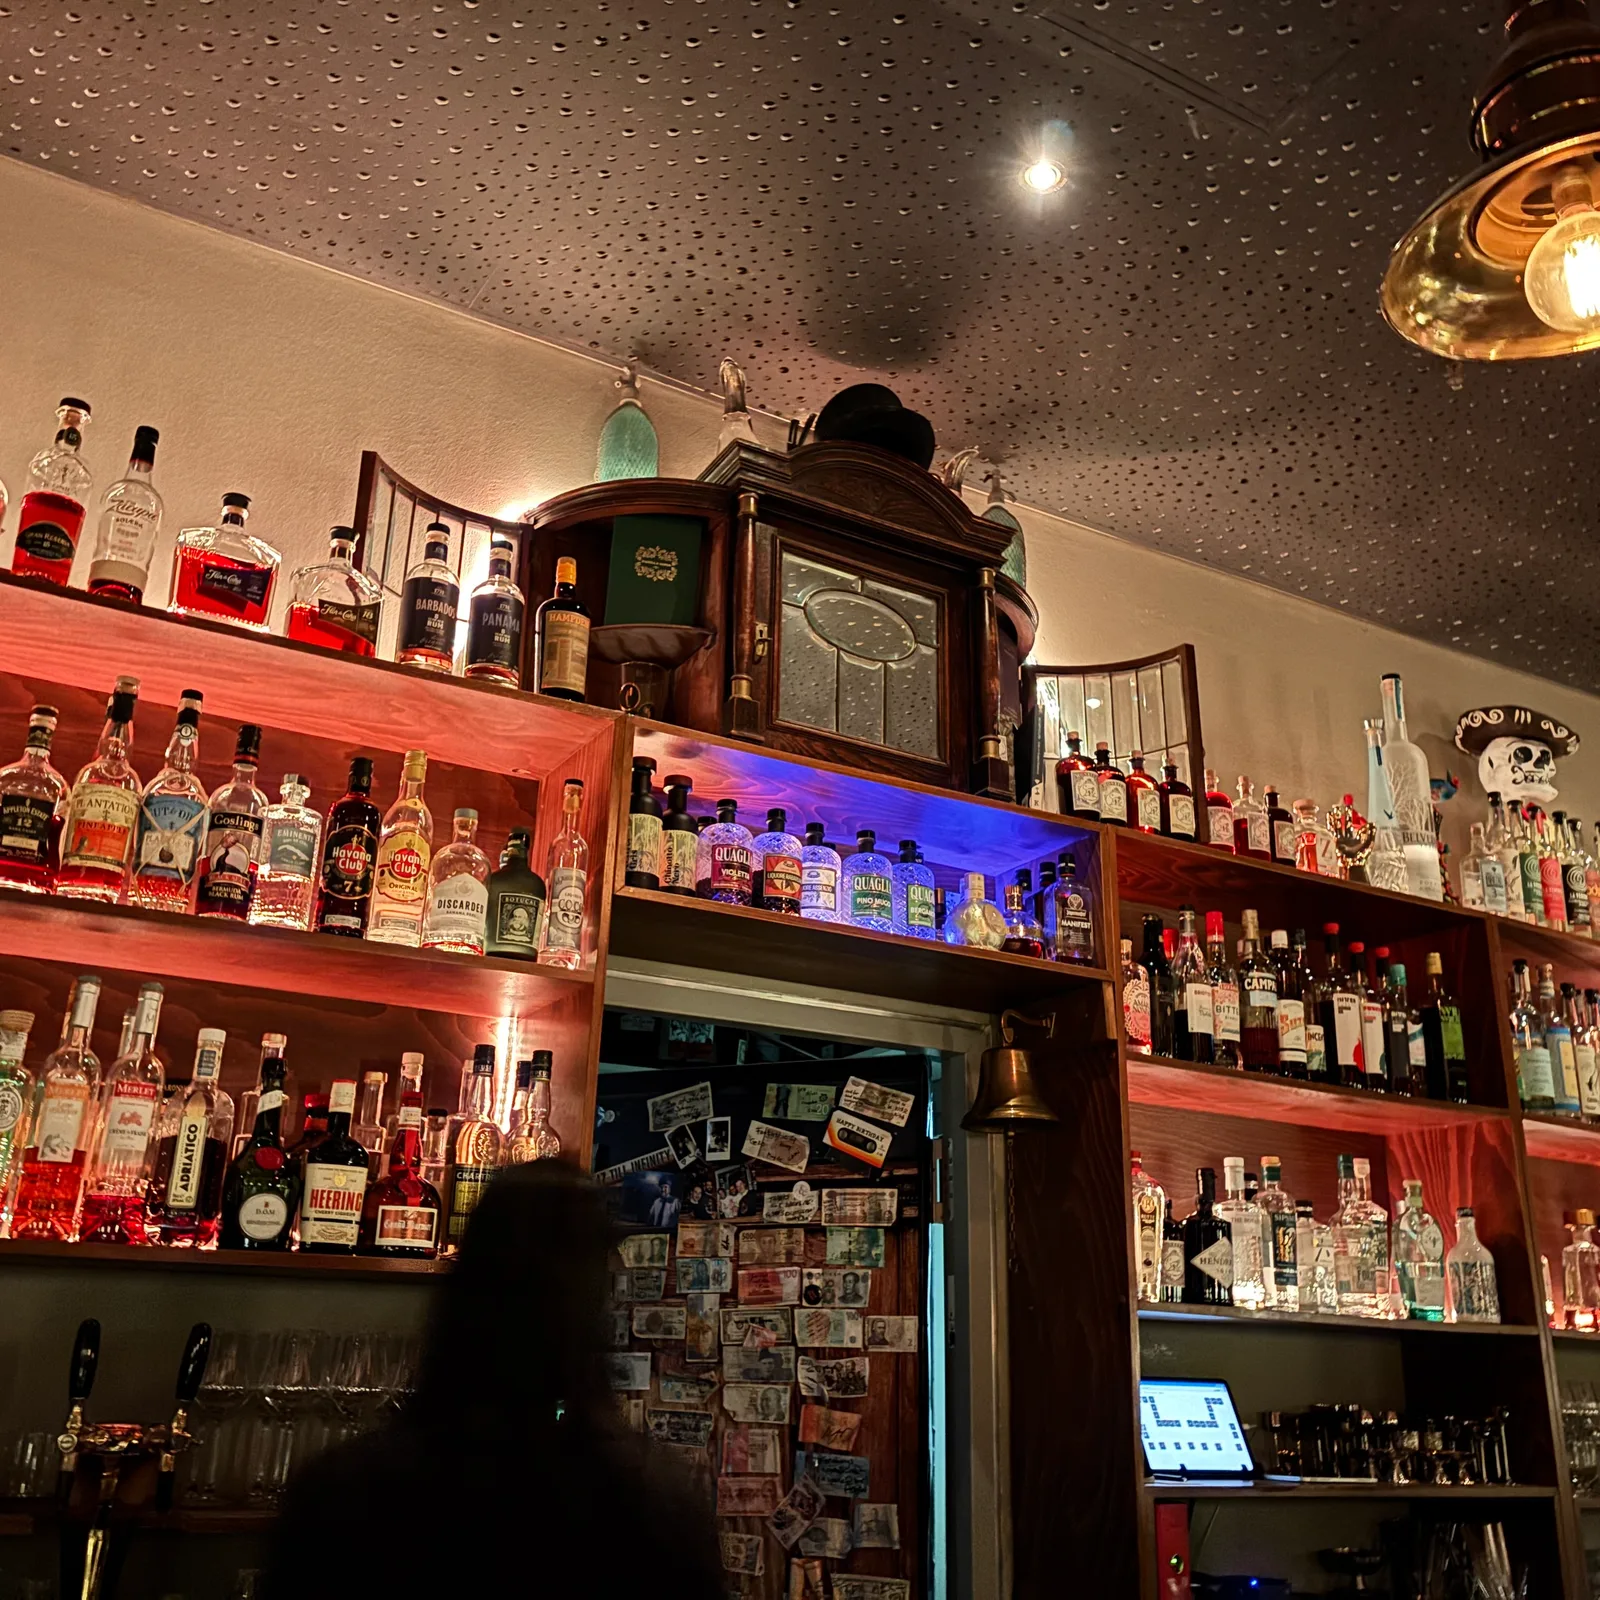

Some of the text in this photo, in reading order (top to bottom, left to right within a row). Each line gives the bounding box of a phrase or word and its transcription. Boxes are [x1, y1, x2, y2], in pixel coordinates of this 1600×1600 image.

[415, 598, 456, 620] BARBADOS
[426, 620, 444, 630] RUM
[482, 612, 520, 634] PANAMA
[493, 635, 511, 645] RUM
[3, 805, 50, 821] APPLETON ESTATE
[76, 797, 134, 816] PLANTATION
[16, 817, 33, 828] 12
[77, 820, 126, 835] PINEAPPLE
[214, 814, 259, 832] Goslings
[277, 828, 314, 842] EMINENTE
[332, 846, 372, 862] Havana
[388, 850, 426, 866] Havana
[715, 847, 751, 865] QUAGLI
[338, 858, 363, 871] Club
[393, 862, 417, 875] Club
[664, 847, 673, 884] Chinotto
[671, 862, 680, 884] Nero
[211, 885, 242, 895] BERMUDA
[343, 880, 353, 893] 7
[388, 882, 418, 893] ORIGINAL
[854, 876, 892, 893] QUAGLI
[208, 891, 229, 899] BLACK
[505, 896, 538, 906] BOTUCAL
[856, 897, 873, 905] PINO
[437, 899, 484, 915] DISCARDED
[1061, 919, 1091, 930] MANIFEST
[117, 1083, 155, 1096] MERLET
[816, 1103, 829, 1115] 20
[836, 1118, 885, 1143] HAPPY BIRTHDAY
[179, 1123, 198, 1193] ADRIATICO
[630, 1149, 670, 1173] INFINITY
[309, 1188, 363, 1212] HEERING
[783, 1269, 798, 1279] 100
